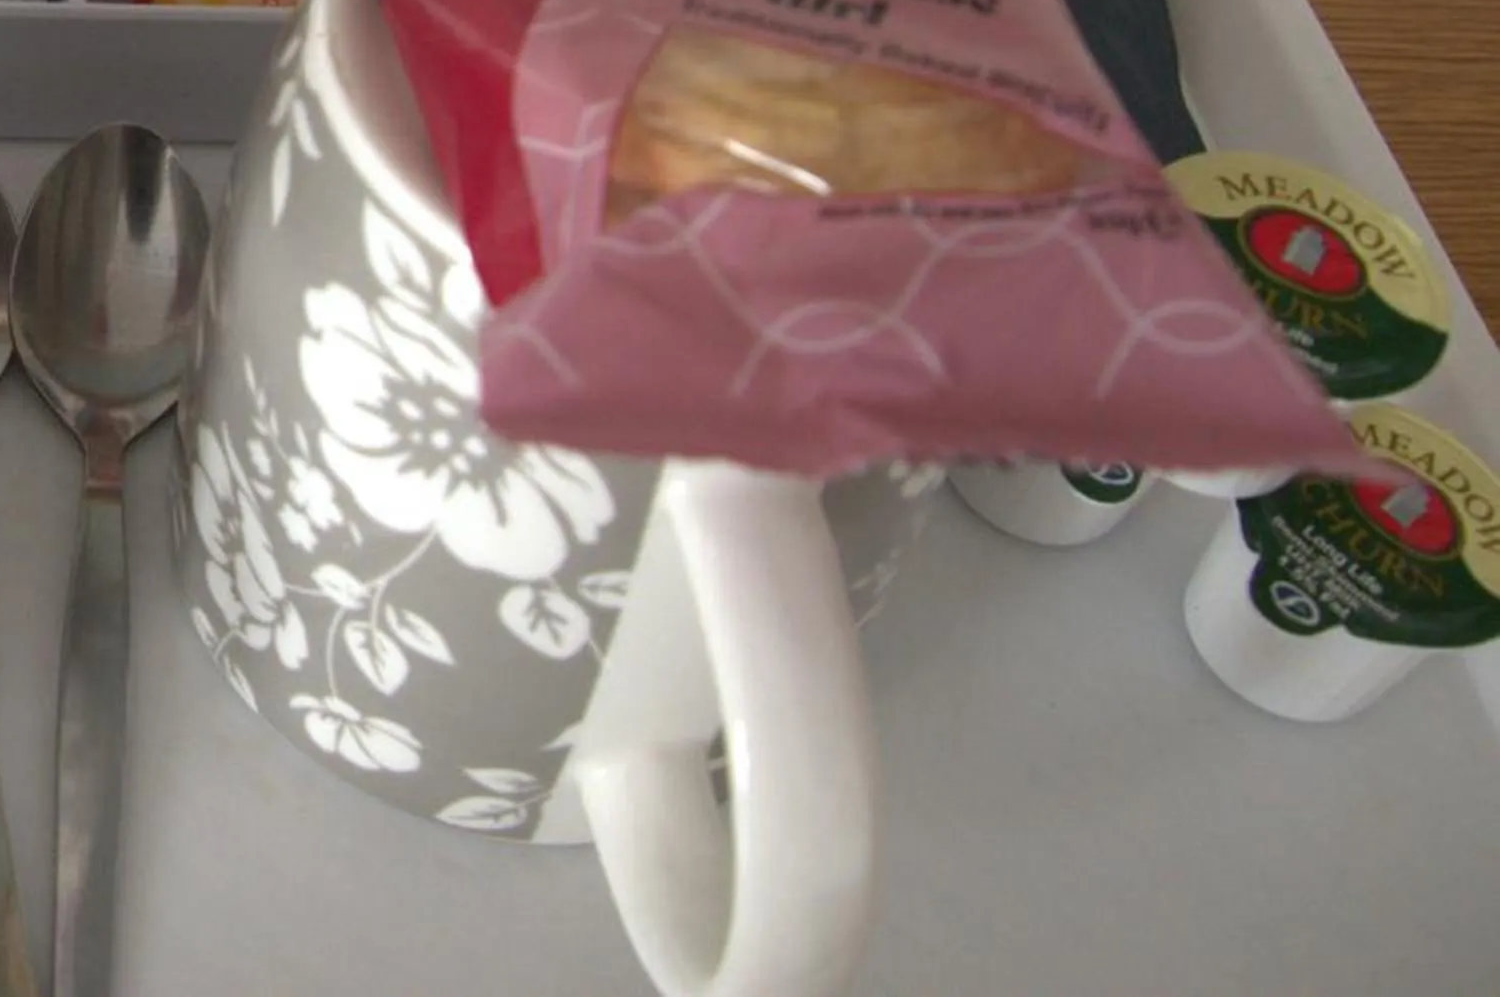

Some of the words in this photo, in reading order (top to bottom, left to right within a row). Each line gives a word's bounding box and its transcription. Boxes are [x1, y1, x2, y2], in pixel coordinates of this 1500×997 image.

[1214, 172, 1417, 281] MEADOW
[1350, 422, 1500, 553] MEADOW
[1302, 524, 1348, 567] Long
